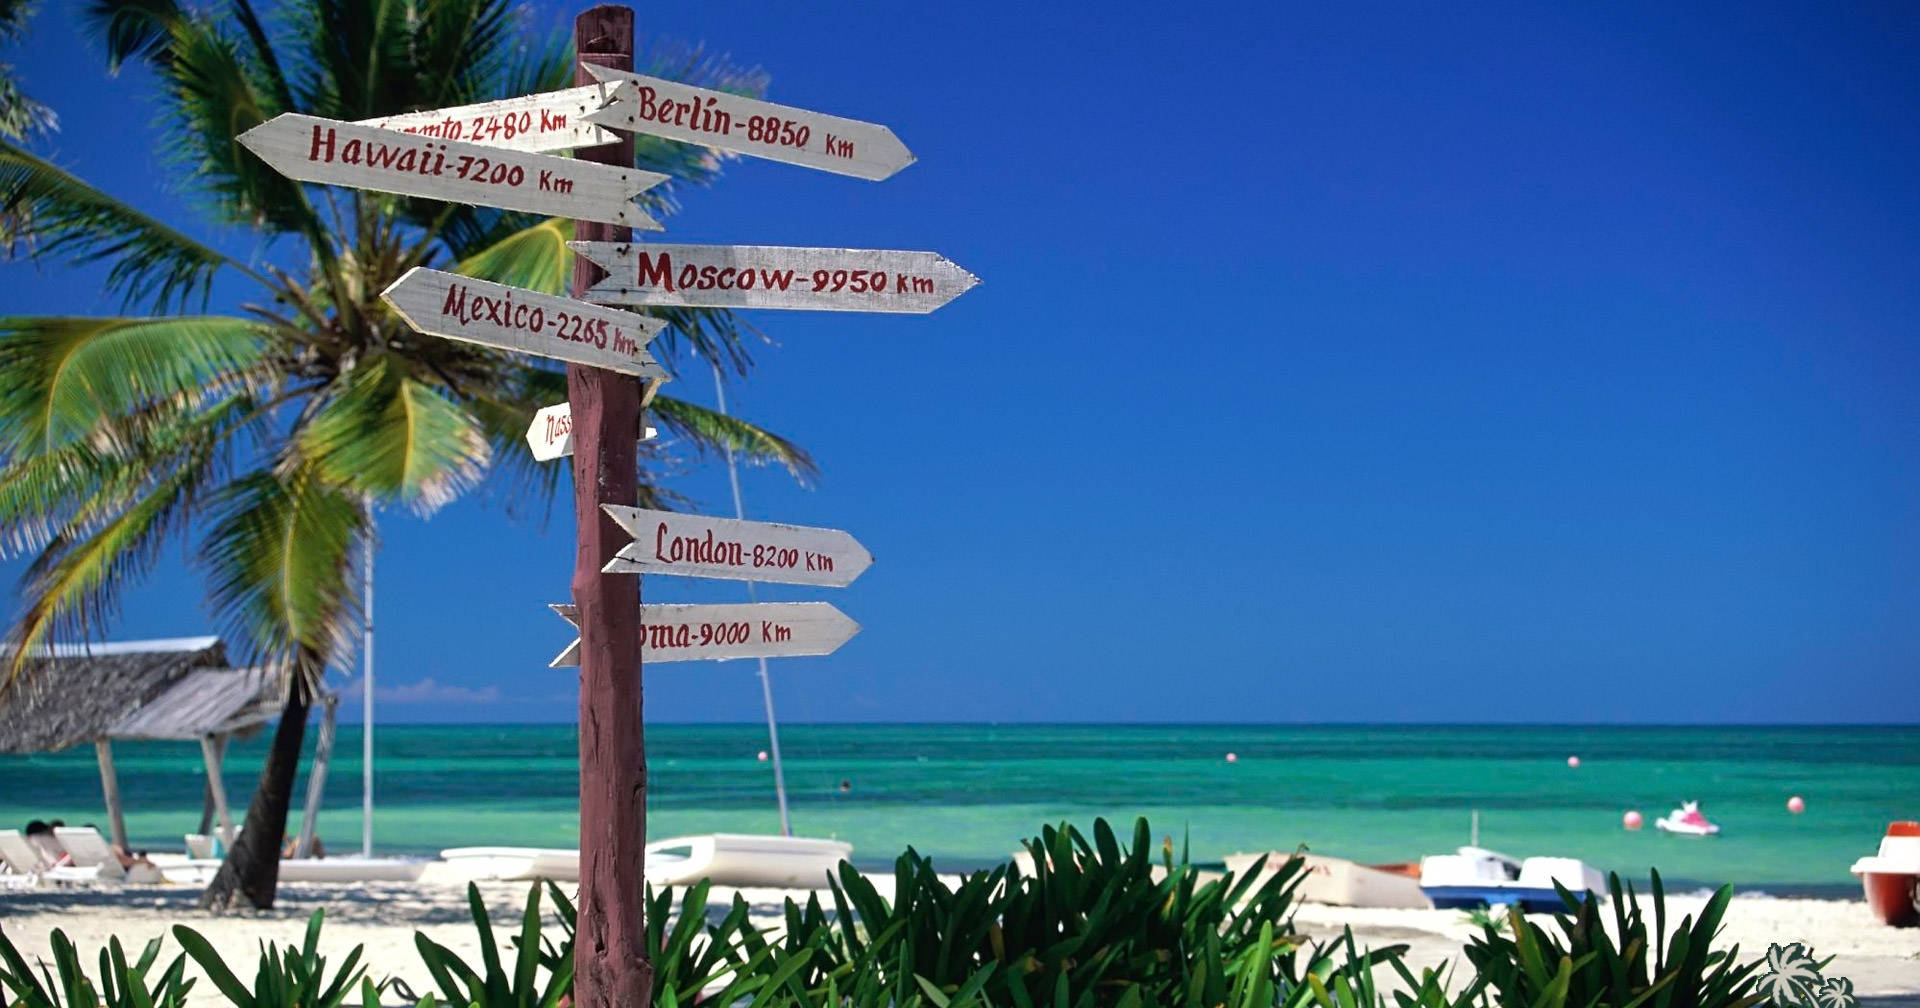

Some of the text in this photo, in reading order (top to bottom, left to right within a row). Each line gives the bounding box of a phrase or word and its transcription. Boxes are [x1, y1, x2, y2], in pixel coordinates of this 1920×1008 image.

[309, 125, 524, 187] Hawaii-7200
[638, 251, 887, 292] Moscow-9950
[442, 283, 609, 350] Mexico-2265
[655, 522, 798, 568] London-8200
[640, 622, 750, 649] oma-9000
